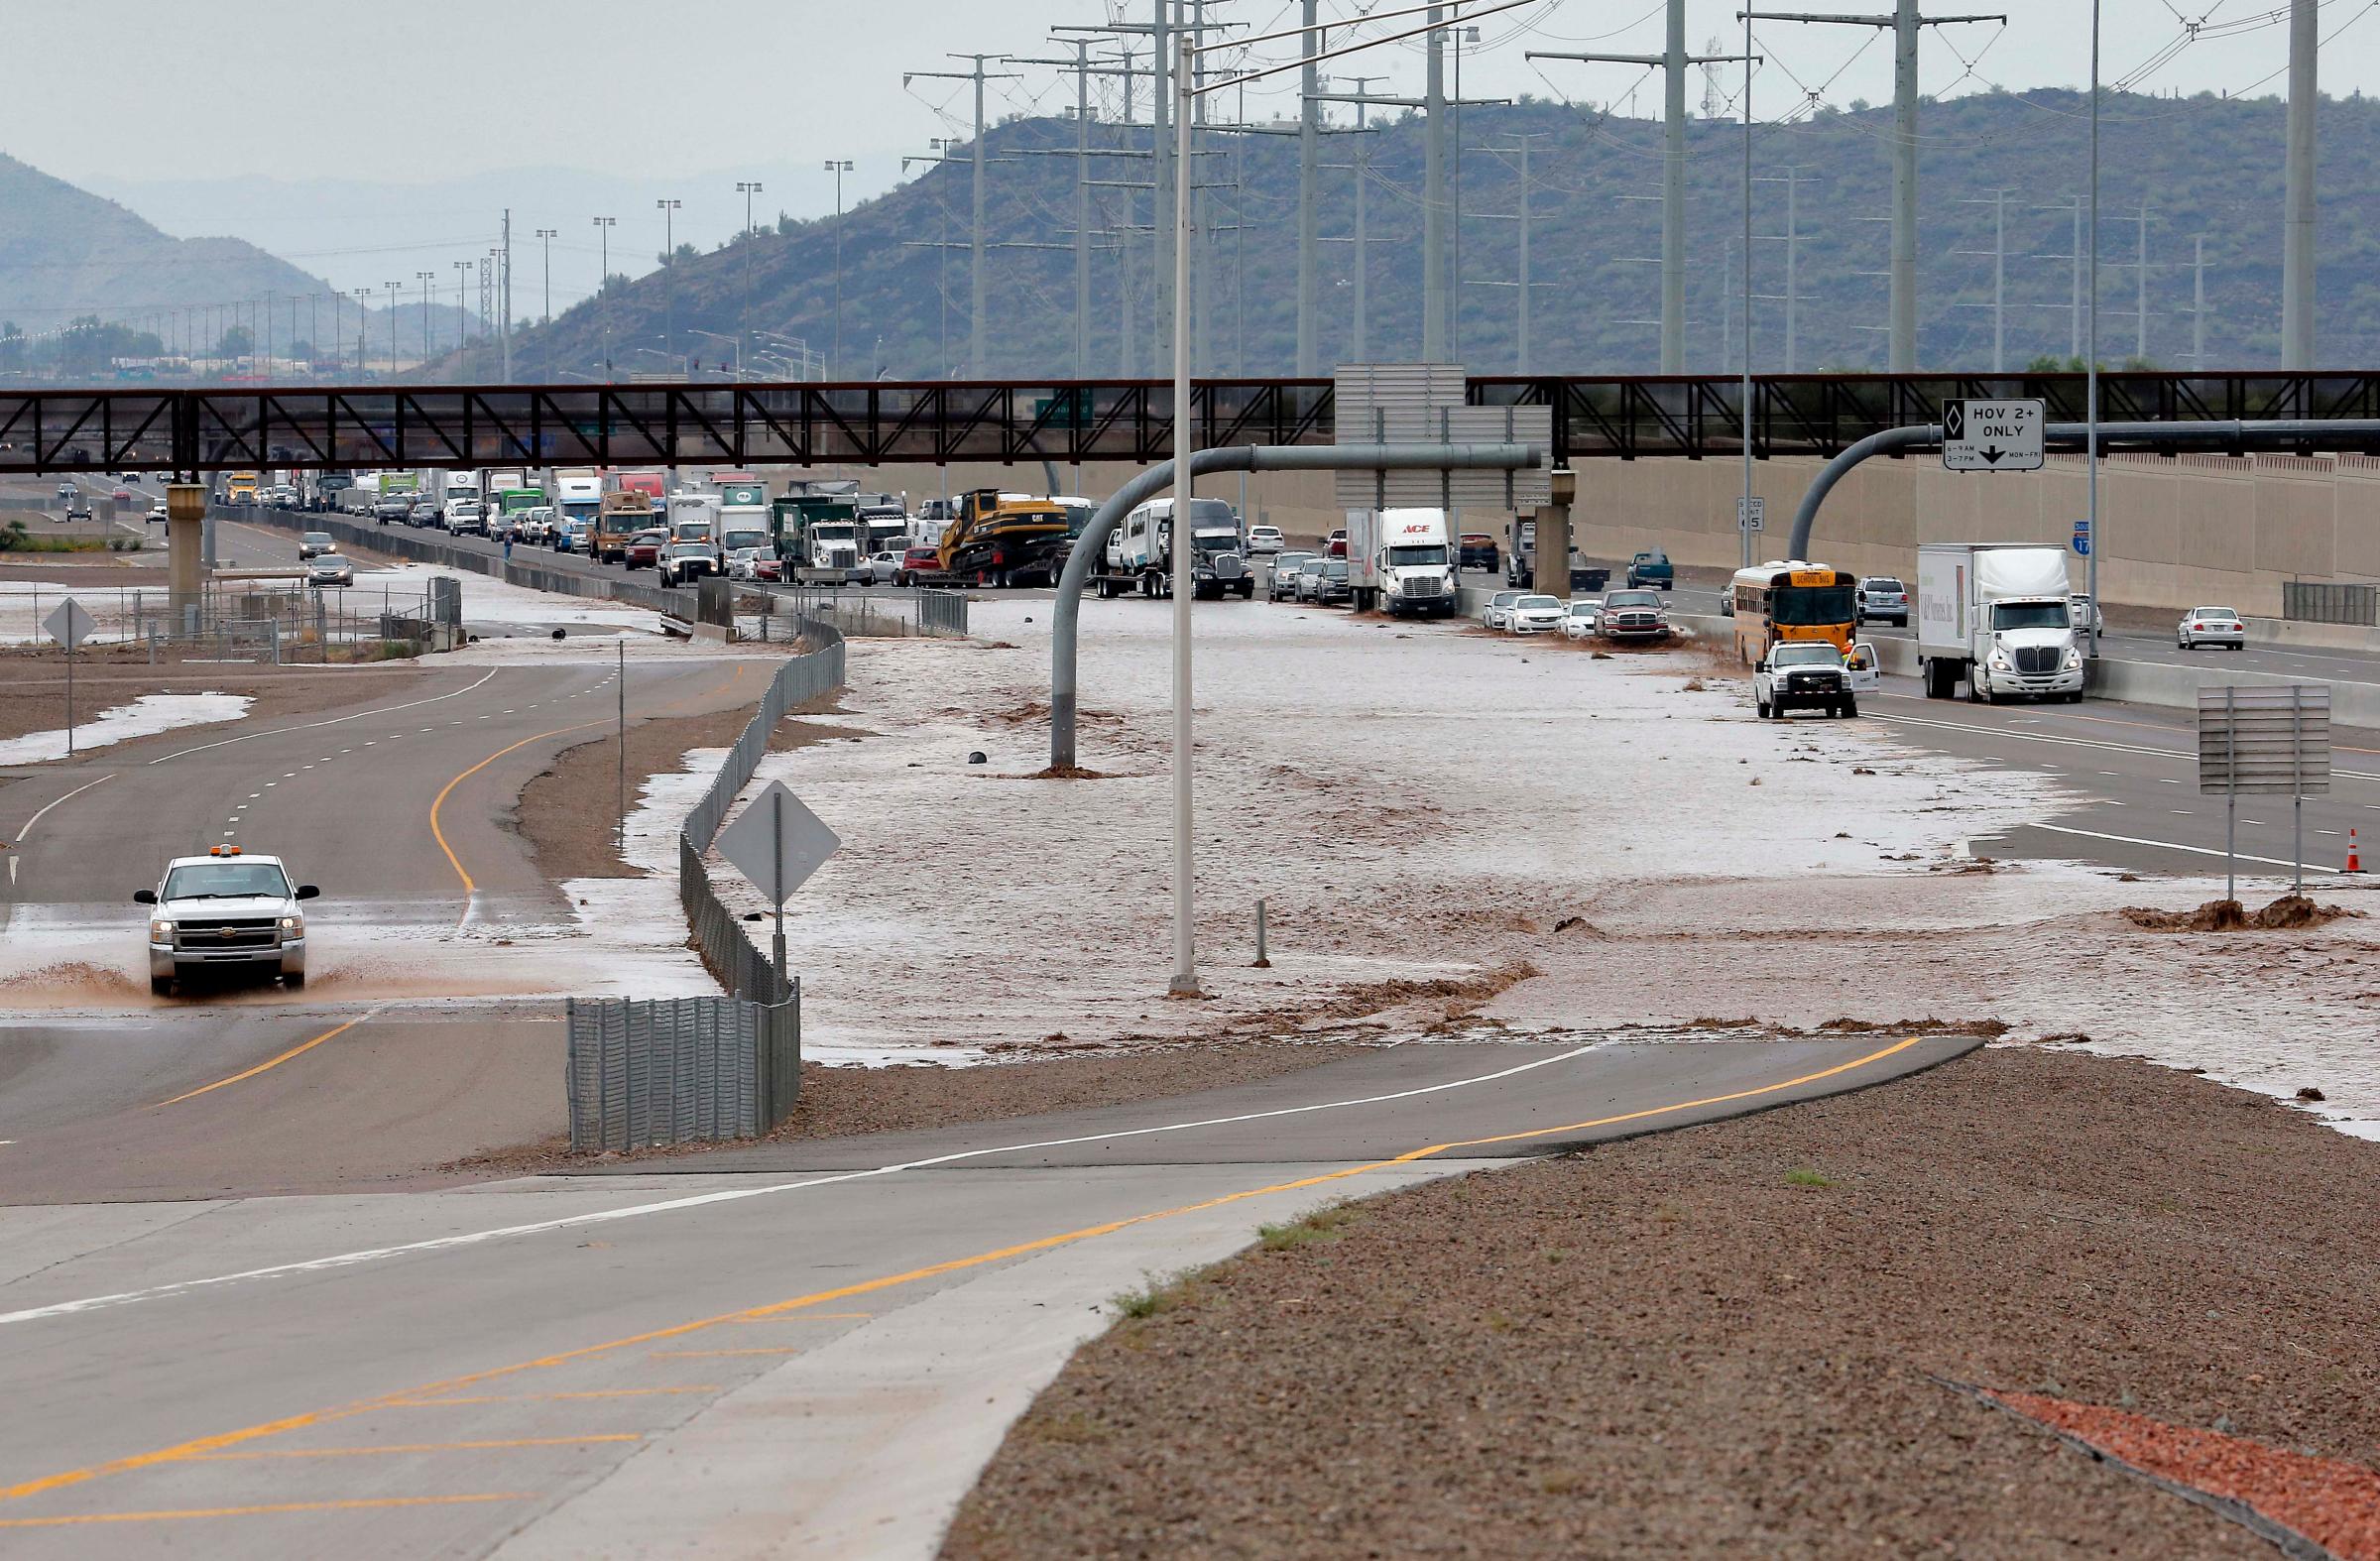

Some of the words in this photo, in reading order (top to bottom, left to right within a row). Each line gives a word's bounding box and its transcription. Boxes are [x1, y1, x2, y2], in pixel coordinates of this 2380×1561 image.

[1973, 408, 2005, 420] HOV
[2014, 408, 2034, 420] 2+
[1983, 425, 2024, 436] ONLY
[1031, 514, 1044, 523] CAT
[1402, 525, 1431, 534] ACE
[2078, 540, 2089, 551] 17
[1796, 574, 1818, 584] SCHOOL
[1819, 574, 1831, 584] BUS
